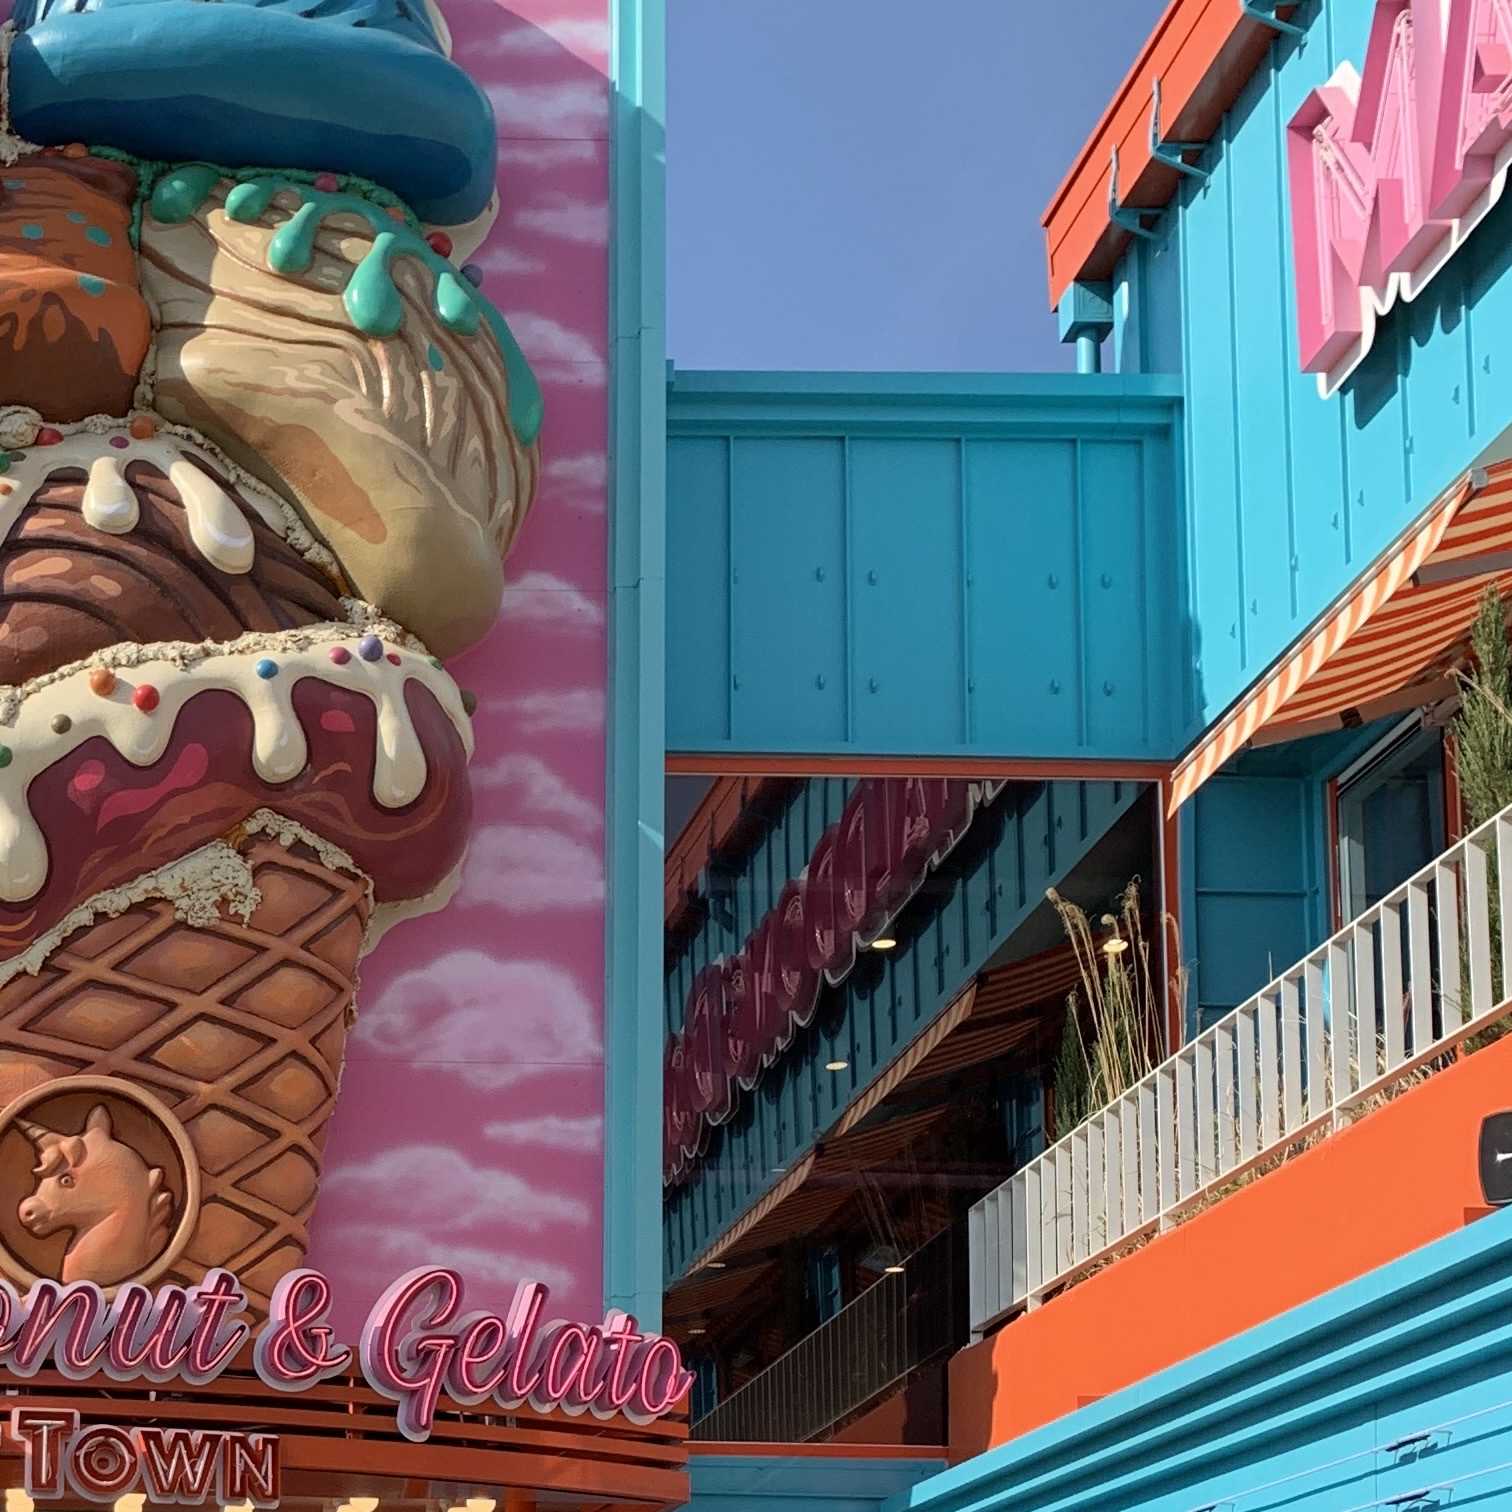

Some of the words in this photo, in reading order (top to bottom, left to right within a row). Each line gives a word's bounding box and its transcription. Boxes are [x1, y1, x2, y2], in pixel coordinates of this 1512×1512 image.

[253, 1269, 352, 1391] &
[360, 1264, 696, 1443] Gelato
[11, 1408, 281, 1510] TOWN
